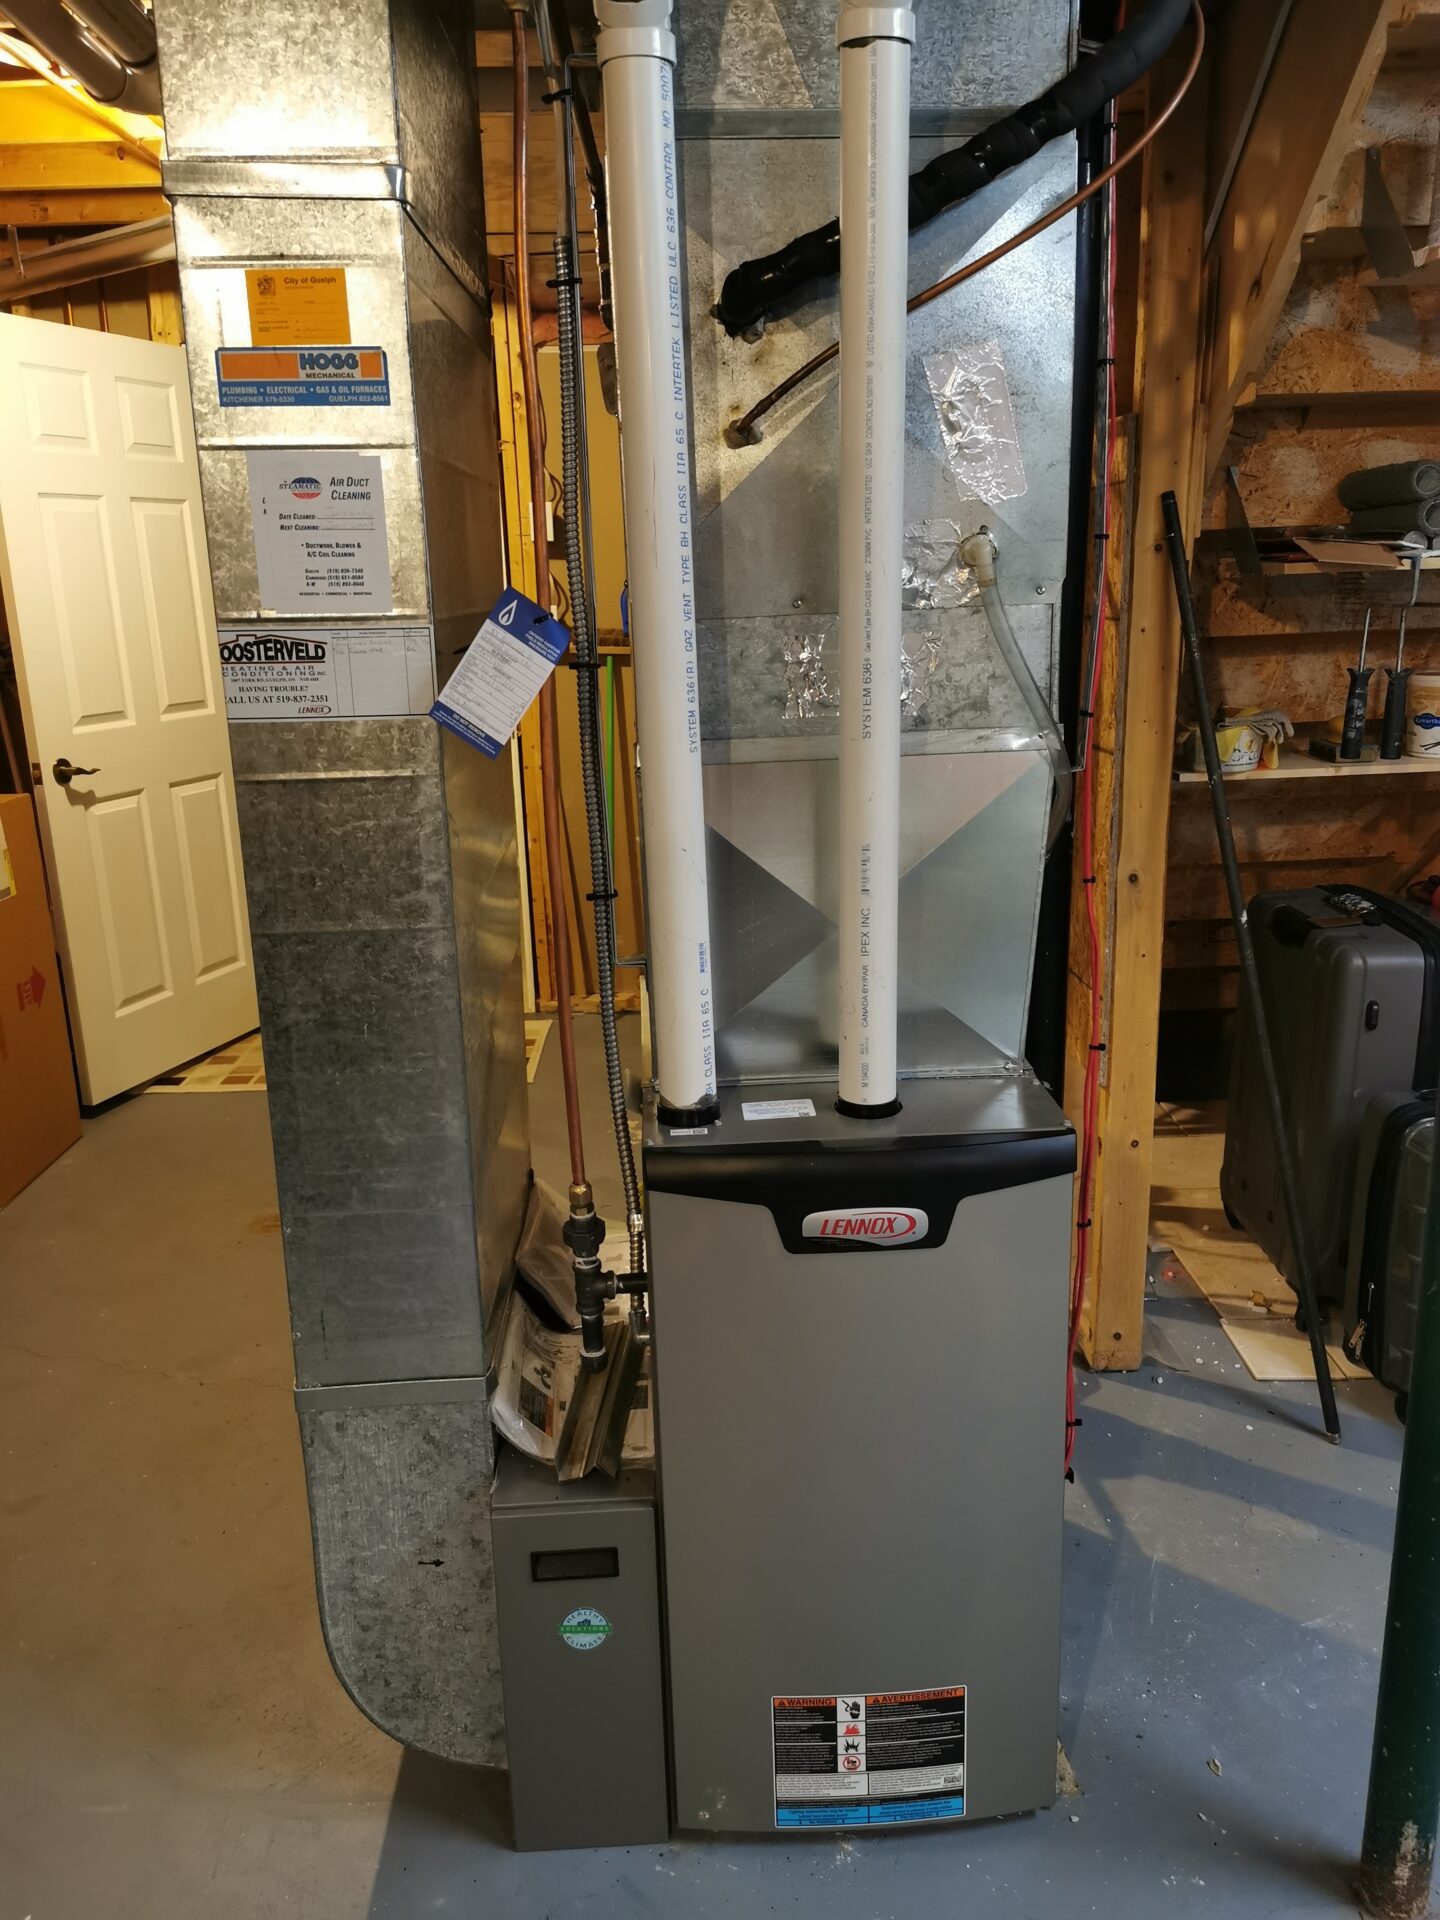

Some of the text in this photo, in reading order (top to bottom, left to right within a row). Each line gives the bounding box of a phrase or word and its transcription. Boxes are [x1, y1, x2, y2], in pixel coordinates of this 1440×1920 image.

[662, 110, 671, 128] NO
[664, 142, 674, 200] CONTROL
[666, 208, 676, 233] 636
[668, 242, 677, 268] ULC
[669, 276, 680, 328] LISTED
[300, 353, 358, 370] HOGG
[672, 336, 682, 402] INTERTEK
[222, 386, 258, 394] PLUMBING
[266, 386, 308, 394] ELECTRICAL
[316, 386, 330, 394] GAS
[351, 385, 386, 393] FURNACES
[674, 412, 684, 420] C
[676, 428, 684, 444] 65
[676, 452, 686, 474] IIA
[330, 476, 370, 487] AIR DUCT
[331, 490, 371, 500] CLEANING
[678, 484, 688, 524] CLASS
[680, 532, 688, 548] BH
[682, 555, 690, 584] TYPE
[682, 592, 692, 622] VENT
[220, 638, 326, 661] OOSTERVELD
[684, 629, 694, 652] GAZ
[686, 661, 696, 704] 636(R)
[862, 688, 872, 739] SYSTEM
[467, 723, 485, 737] REMOVE
[688, 710, 698, 753] SYSTEM
[860, 932, 870, 956] IPEX
[700, 988, 709, 996] C
[701, 1002, 710, 1015] 65
[702, 1020, 711, 1040] IIA
[704, 1046, 712, 1078] CLASS
[820, 1216, 898, 1236] LENNOX
[566, 1636, 602, 1648] CLIMATE
[882, 1690, 958, 1702] AVERTISSEMENT
